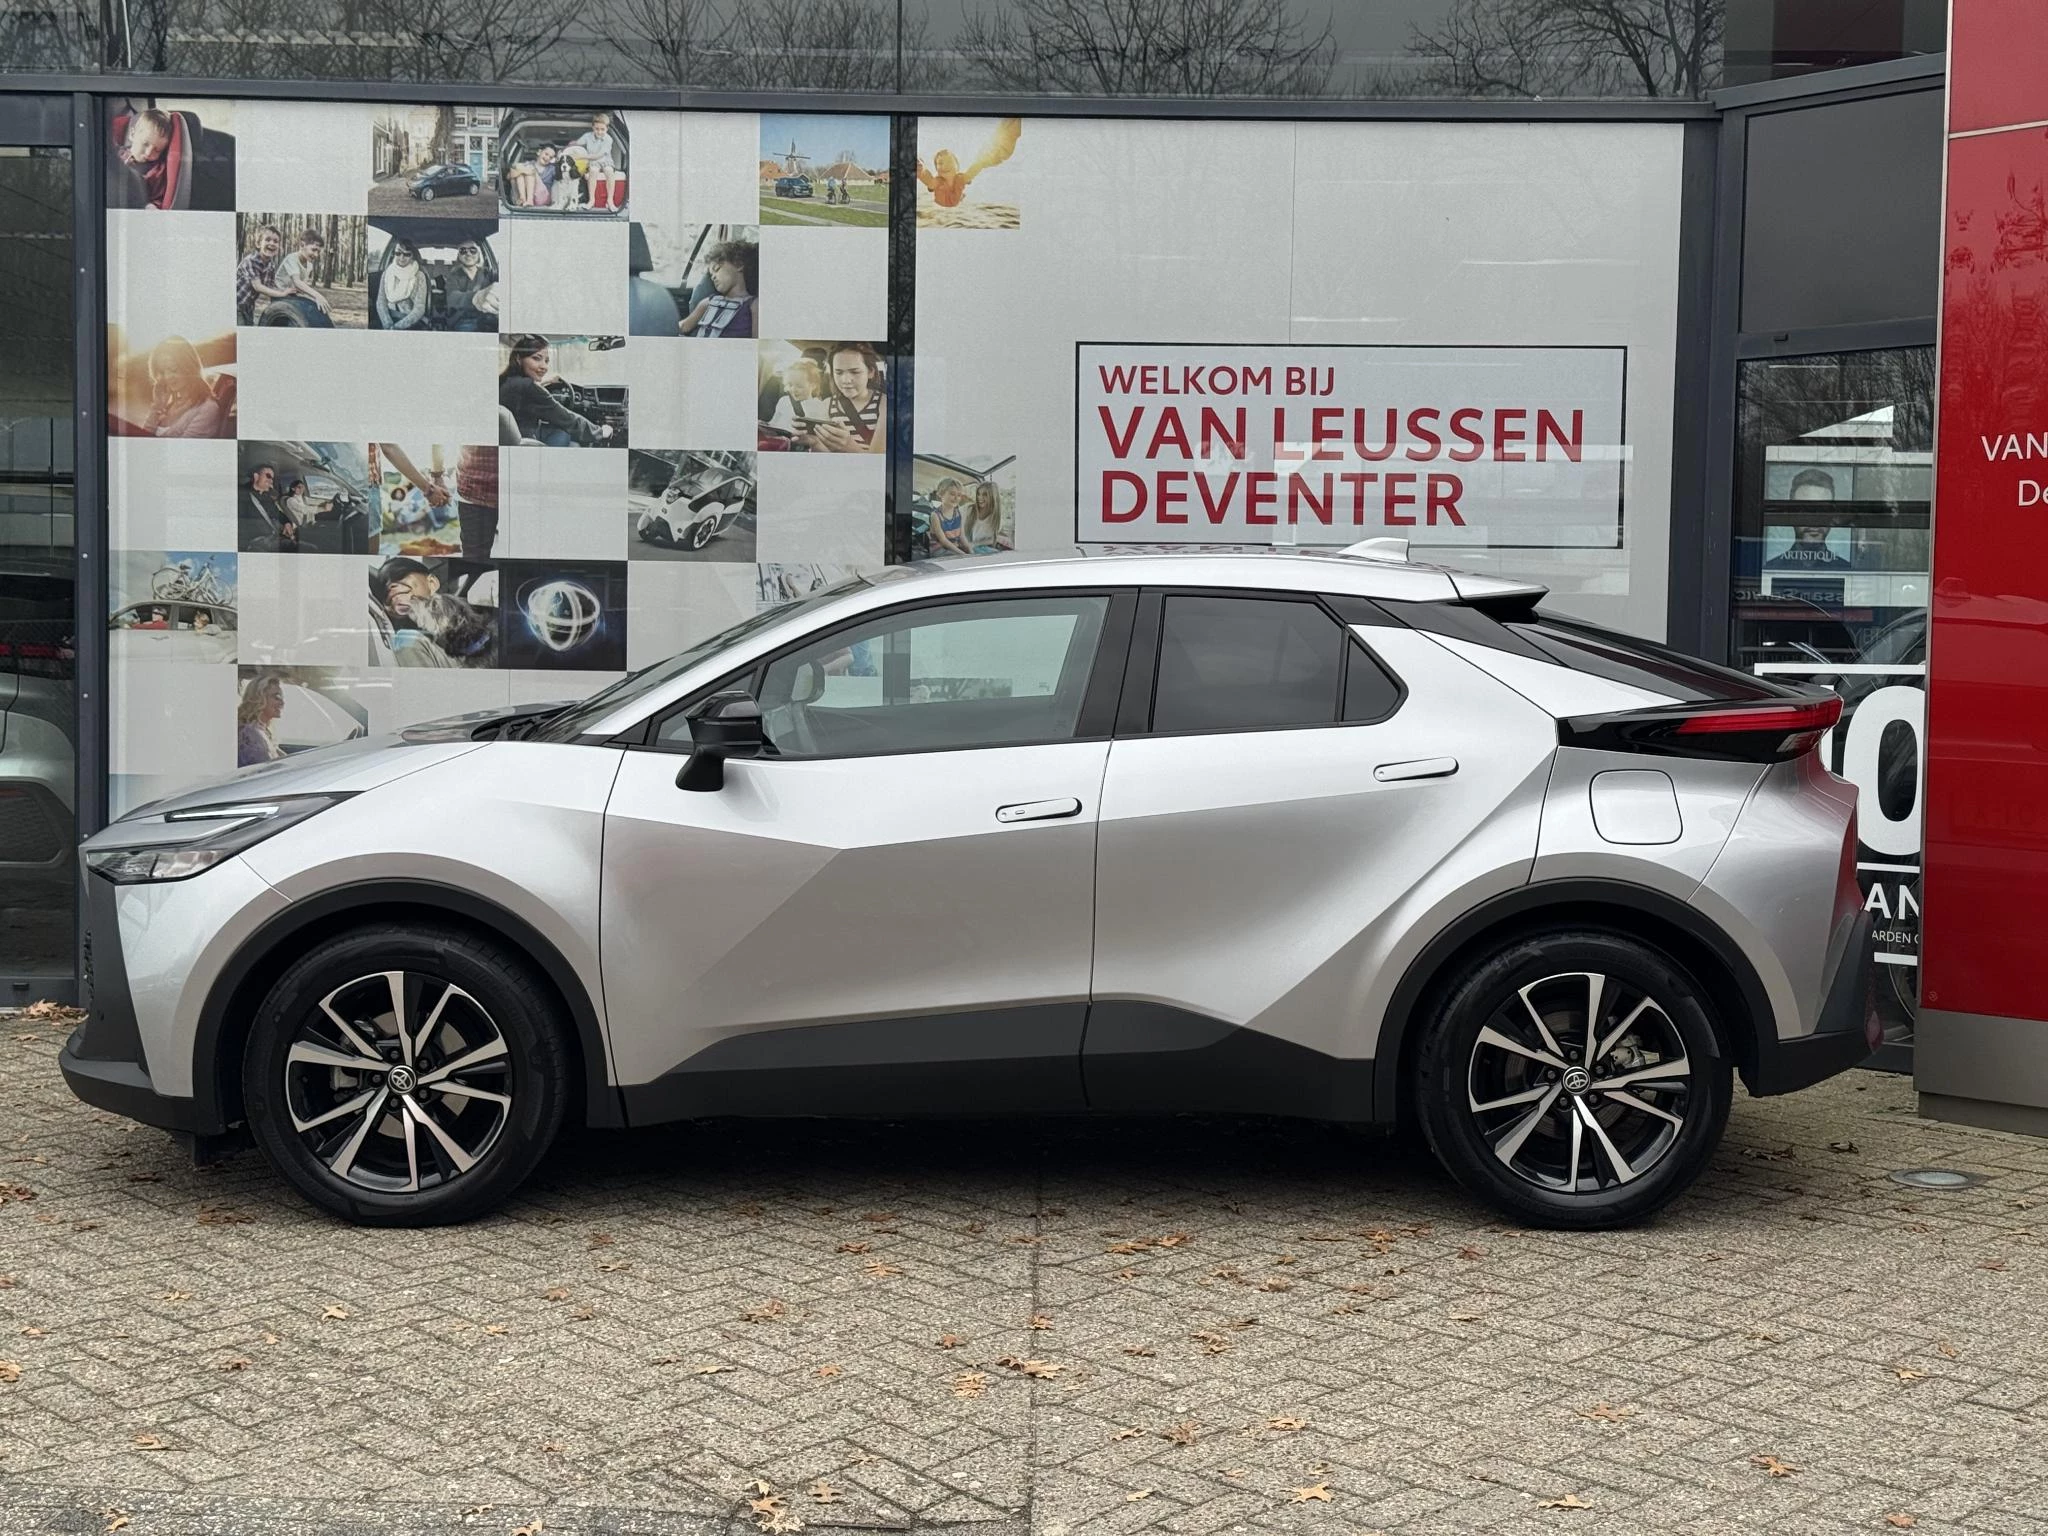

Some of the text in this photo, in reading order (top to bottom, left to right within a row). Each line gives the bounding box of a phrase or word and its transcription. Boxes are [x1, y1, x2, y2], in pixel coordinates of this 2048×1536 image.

[1099, 365, 1335, 396] WELKOM BIJ
[1098, 406, 1583, 463] VAN LEUSSEN
[1981, 432, 2048, 462] VAN
[1101, 469, 1467, 527] DEVENTER
